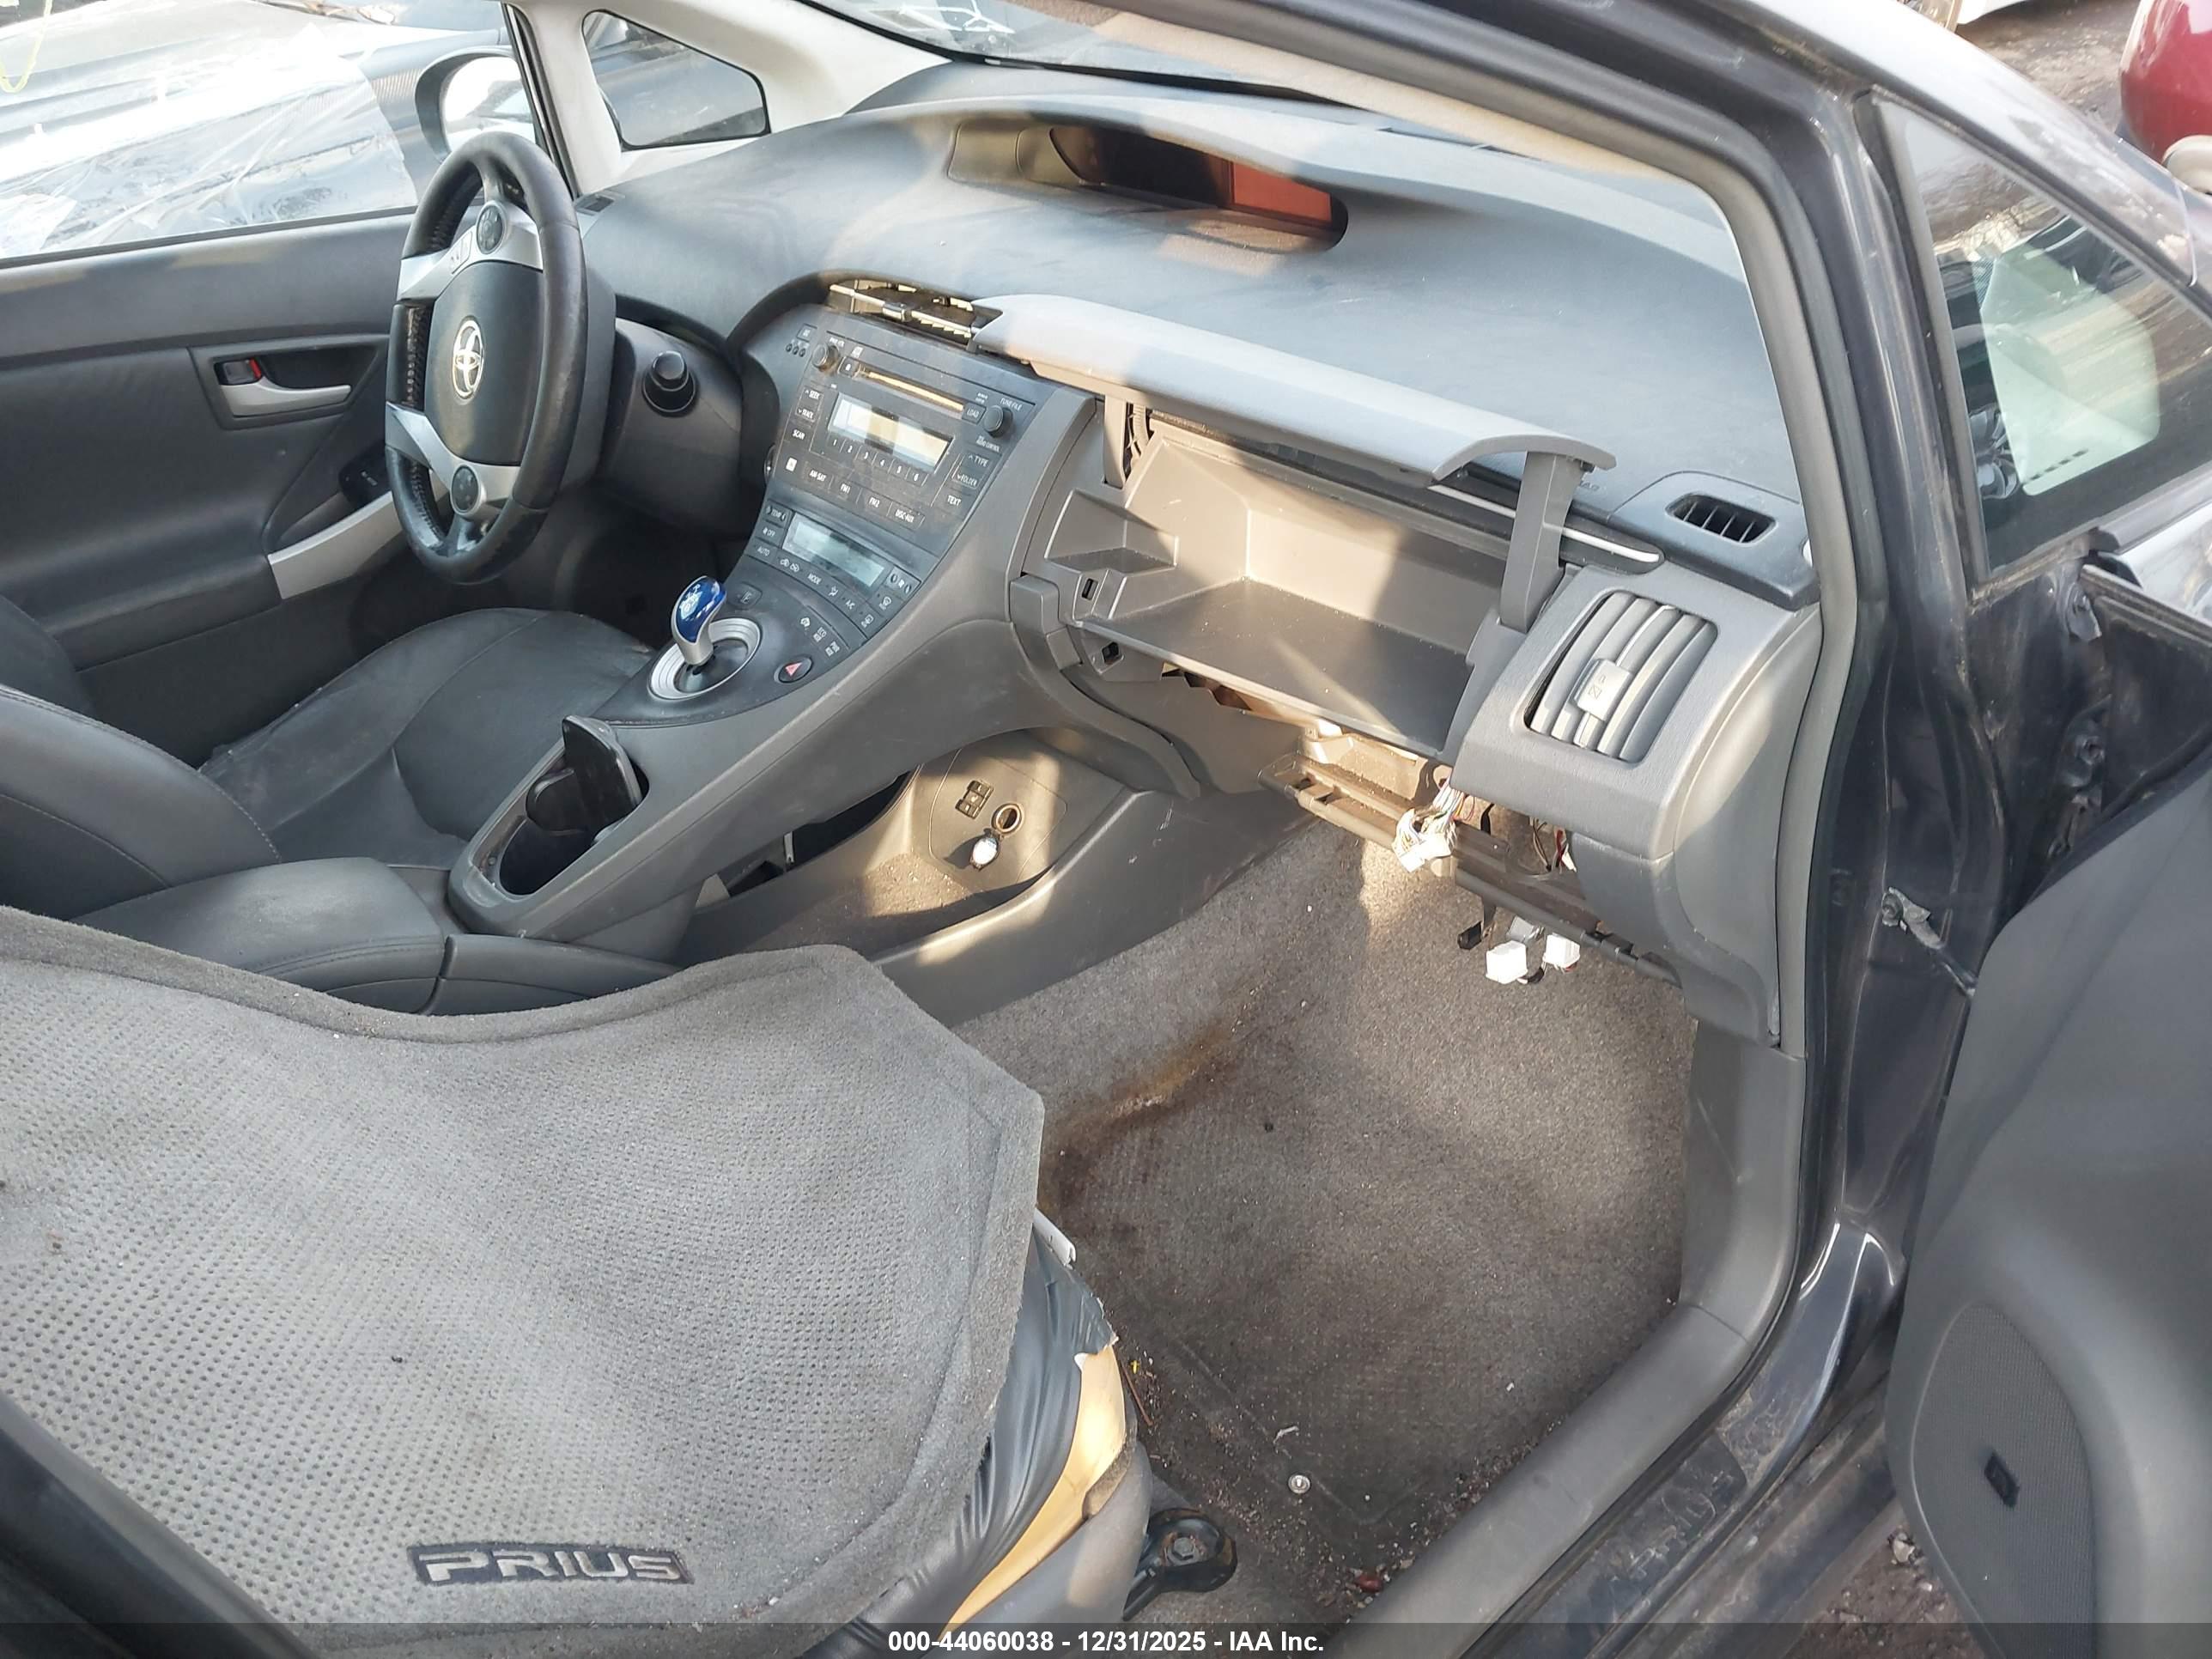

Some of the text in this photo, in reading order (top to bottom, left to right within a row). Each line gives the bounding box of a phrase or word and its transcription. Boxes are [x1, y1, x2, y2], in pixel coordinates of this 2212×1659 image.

[966, 408, 980, 418] LOAD
[792, 428, 805, 441] SCAN
[847, 445, 854, 453] 2
[863, 451, 869, 459] 3
[974, 455, 989, 467] TYPE
[896, 465, 902, 474] 5
[913, 473, 920, 482] 6
[840, 483, 851, 494] FM1
[868, 496, 880, 508] FM2
[947, 495, 962, 507] TEXT
[757, 545, 770, 557] AUTO
[807, 572, 822, 585] MODE
[418, 1548, 681, 1582] PRIUS
